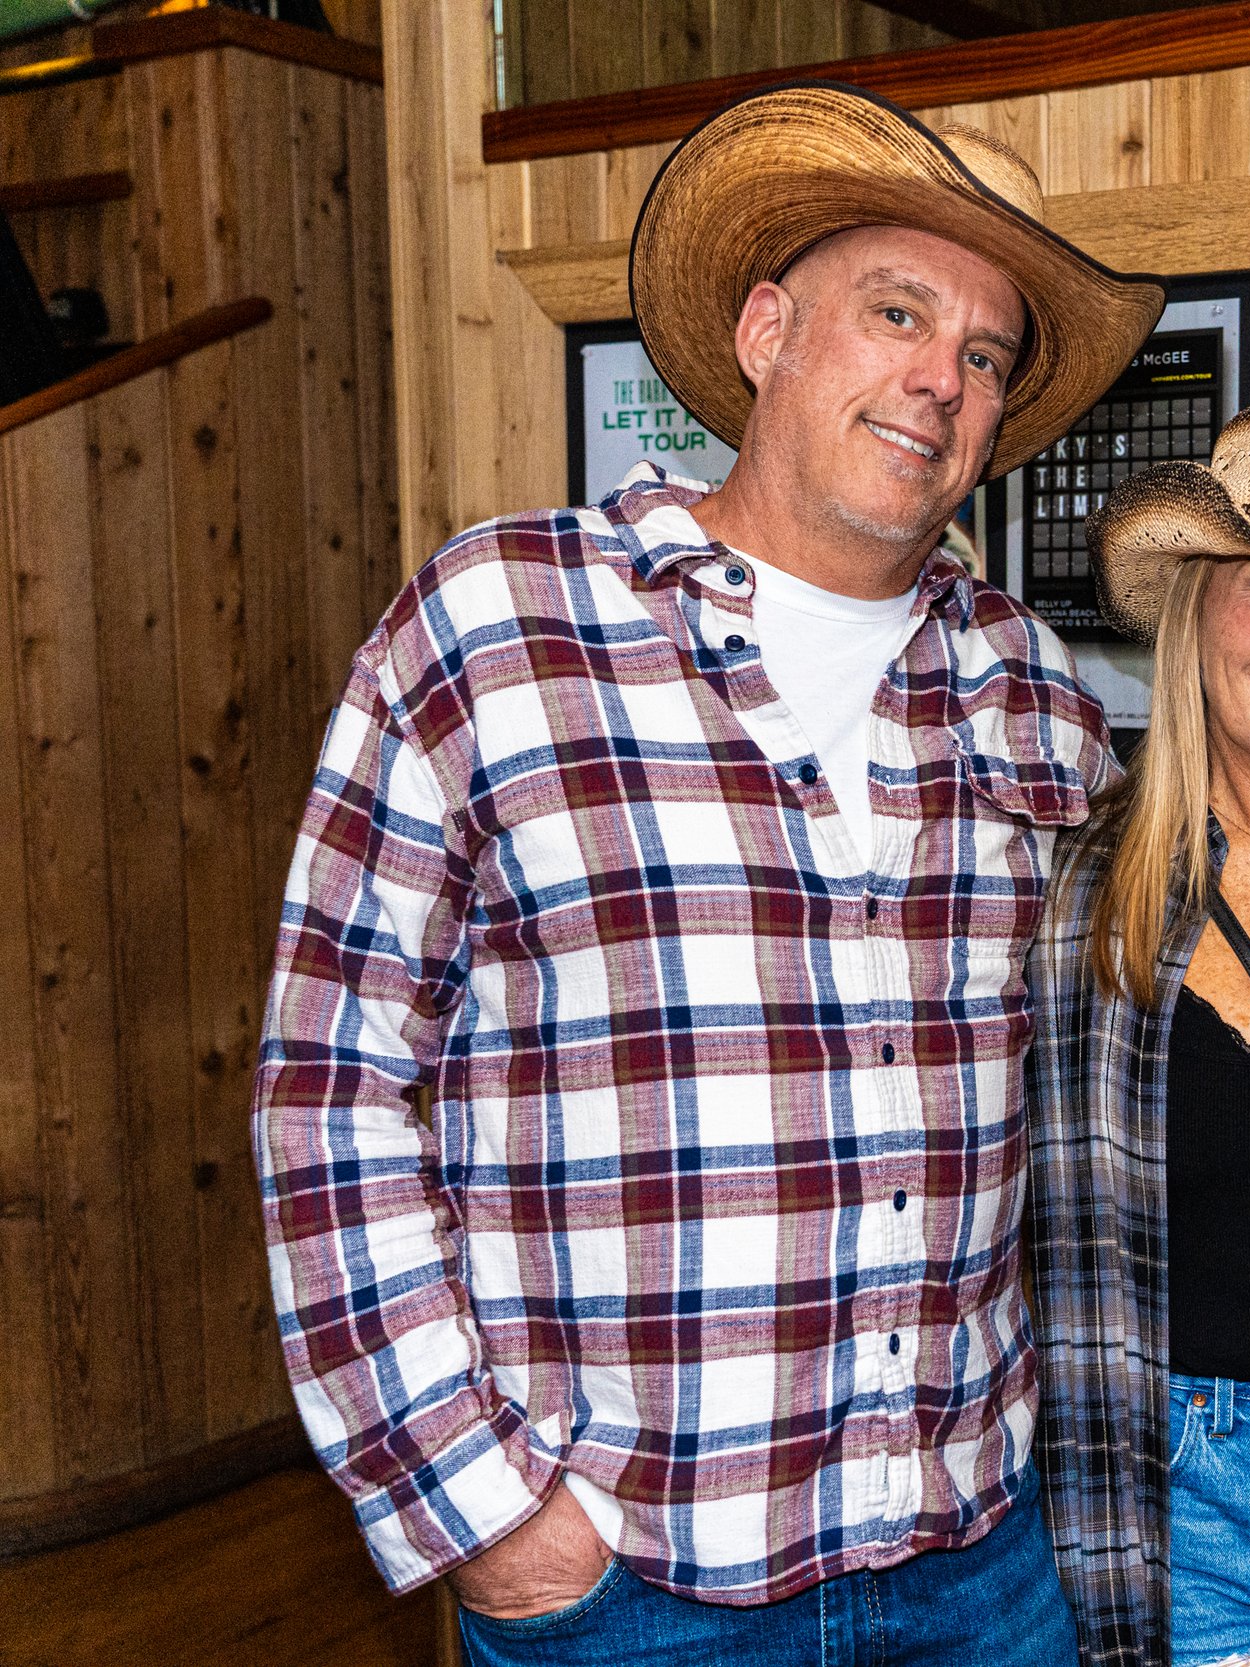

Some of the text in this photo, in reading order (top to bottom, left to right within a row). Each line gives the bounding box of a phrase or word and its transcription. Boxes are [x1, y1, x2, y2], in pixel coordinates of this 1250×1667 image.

[1143, 350, 1190, 366] McGEE
[603, 408, 648, 429] LET
[655, 407, 677, 427] IT
[638, 431, 706, 452] TOUR
[1037, 466, 1086, 488] THE
